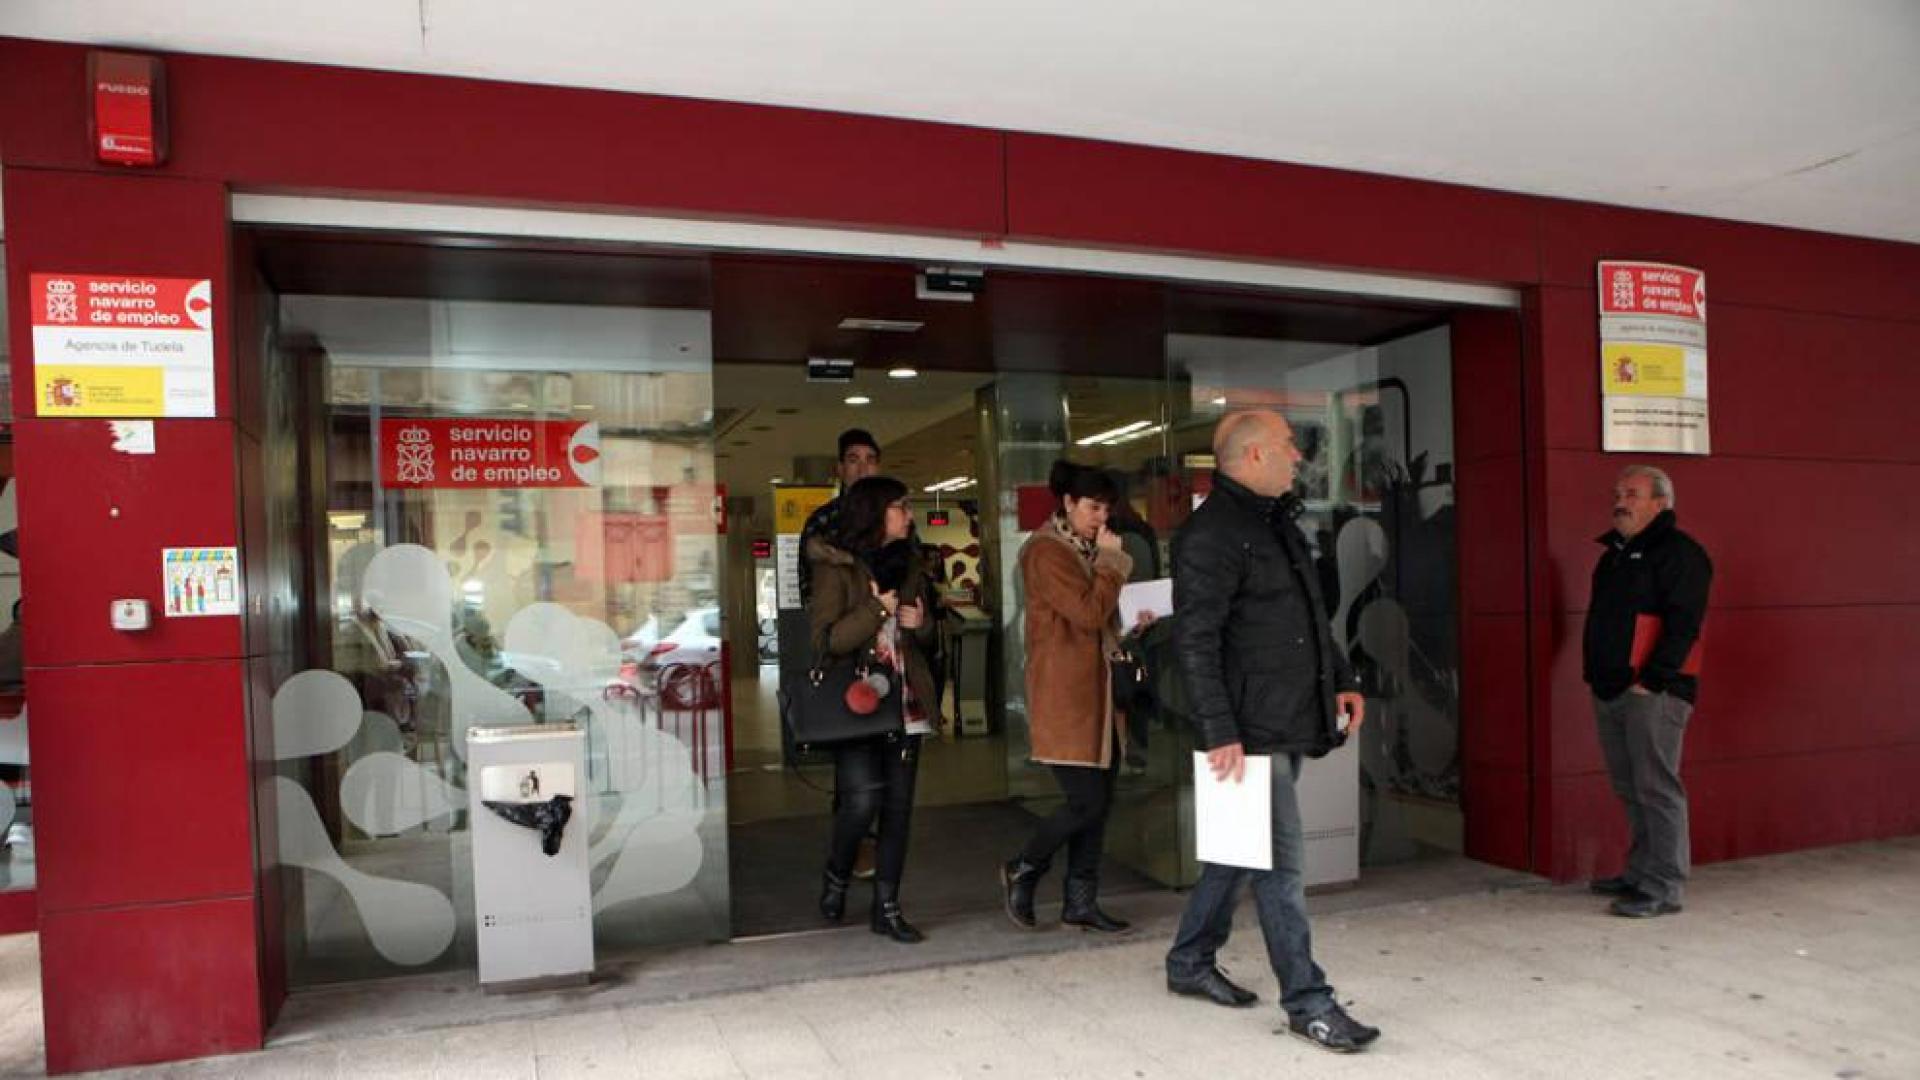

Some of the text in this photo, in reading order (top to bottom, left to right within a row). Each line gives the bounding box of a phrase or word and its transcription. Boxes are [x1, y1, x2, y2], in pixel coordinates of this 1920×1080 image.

[88, 279, 156, 295] servicio
[89, 297, 156, 309] navarro
[1642, 297, 1657, 309] de
[90, 310, 180, 326] de empleo
[64, 338, 185, 354] Agencia de Tudela
[450, 425, 532, 442] servicio
[450, 446, 531, 462] navarro
[451, 464, 562, 485] de empleo
